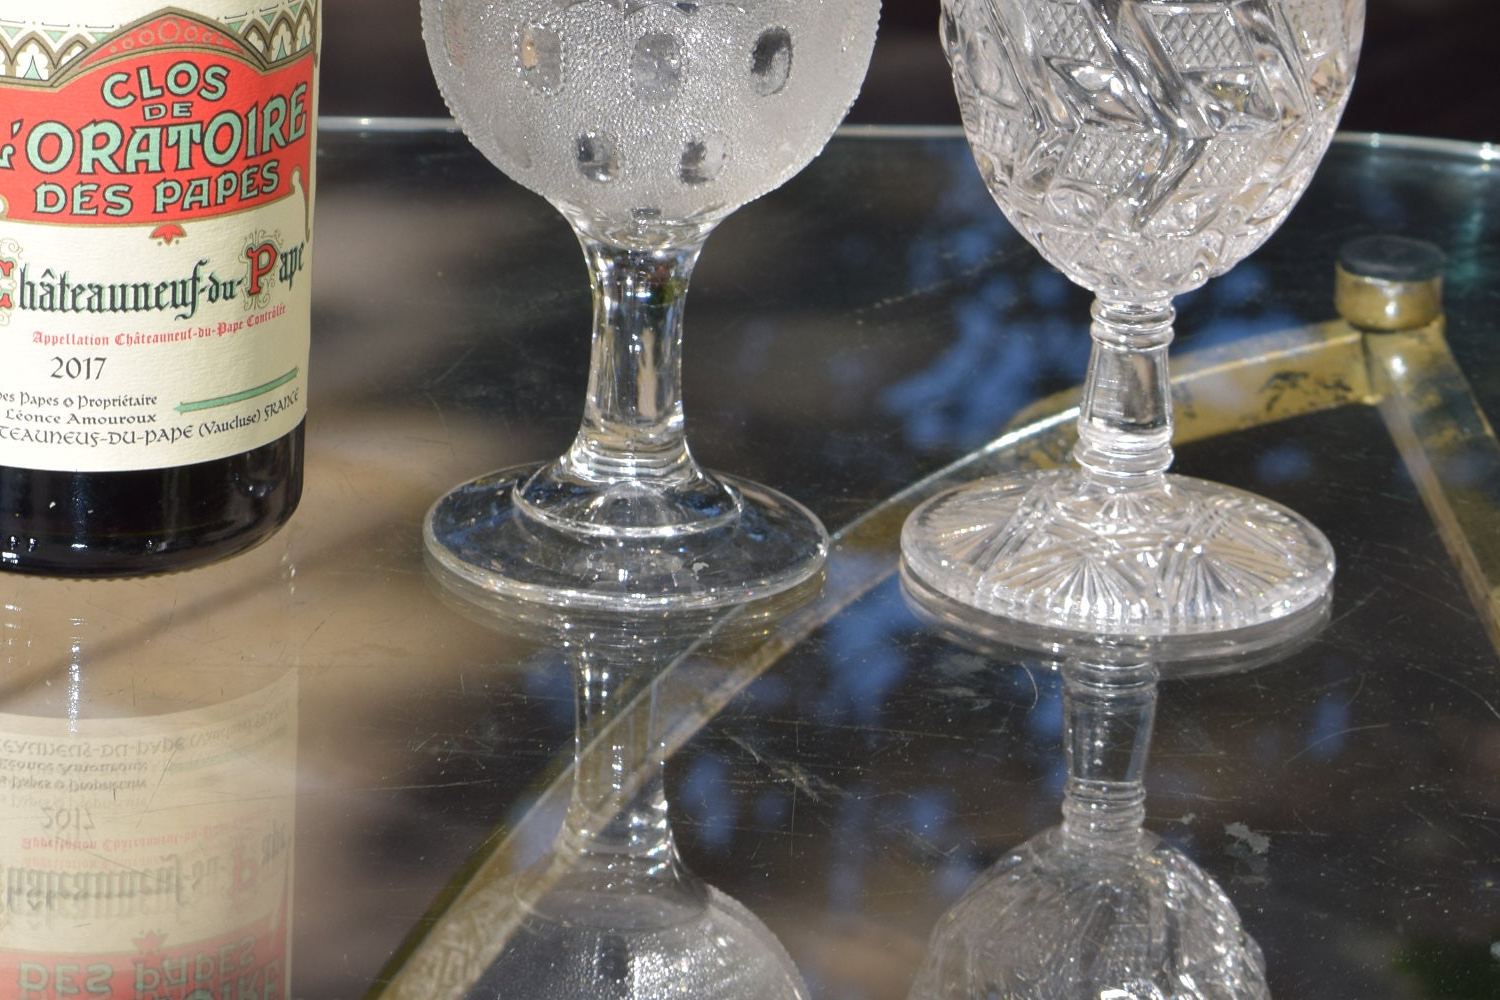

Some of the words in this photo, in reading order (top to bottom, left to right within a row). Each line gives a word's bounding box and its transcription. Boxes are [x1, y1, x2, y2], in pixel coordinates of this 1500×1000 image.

[101, 60, 230, 109] CLOS
[143, 101, 193, 121] DE
[33, 180, 134, 217] DES
[152, 158, 280, 214] PAPES
[32, 331, 109, 346] Appellation
[115, 321, 243, 347] Châteauneuf-du-Pape
[50, 356, 107, 380] 2017
[20, 391, 59, 408] Papes
[78, 394, 157, 410] Propriétaire
[5, 408, 61, 424] Léonce
[66, 413, 157, 425] Amouroux
[198, 409, 261, 438] (Vaucluse)
